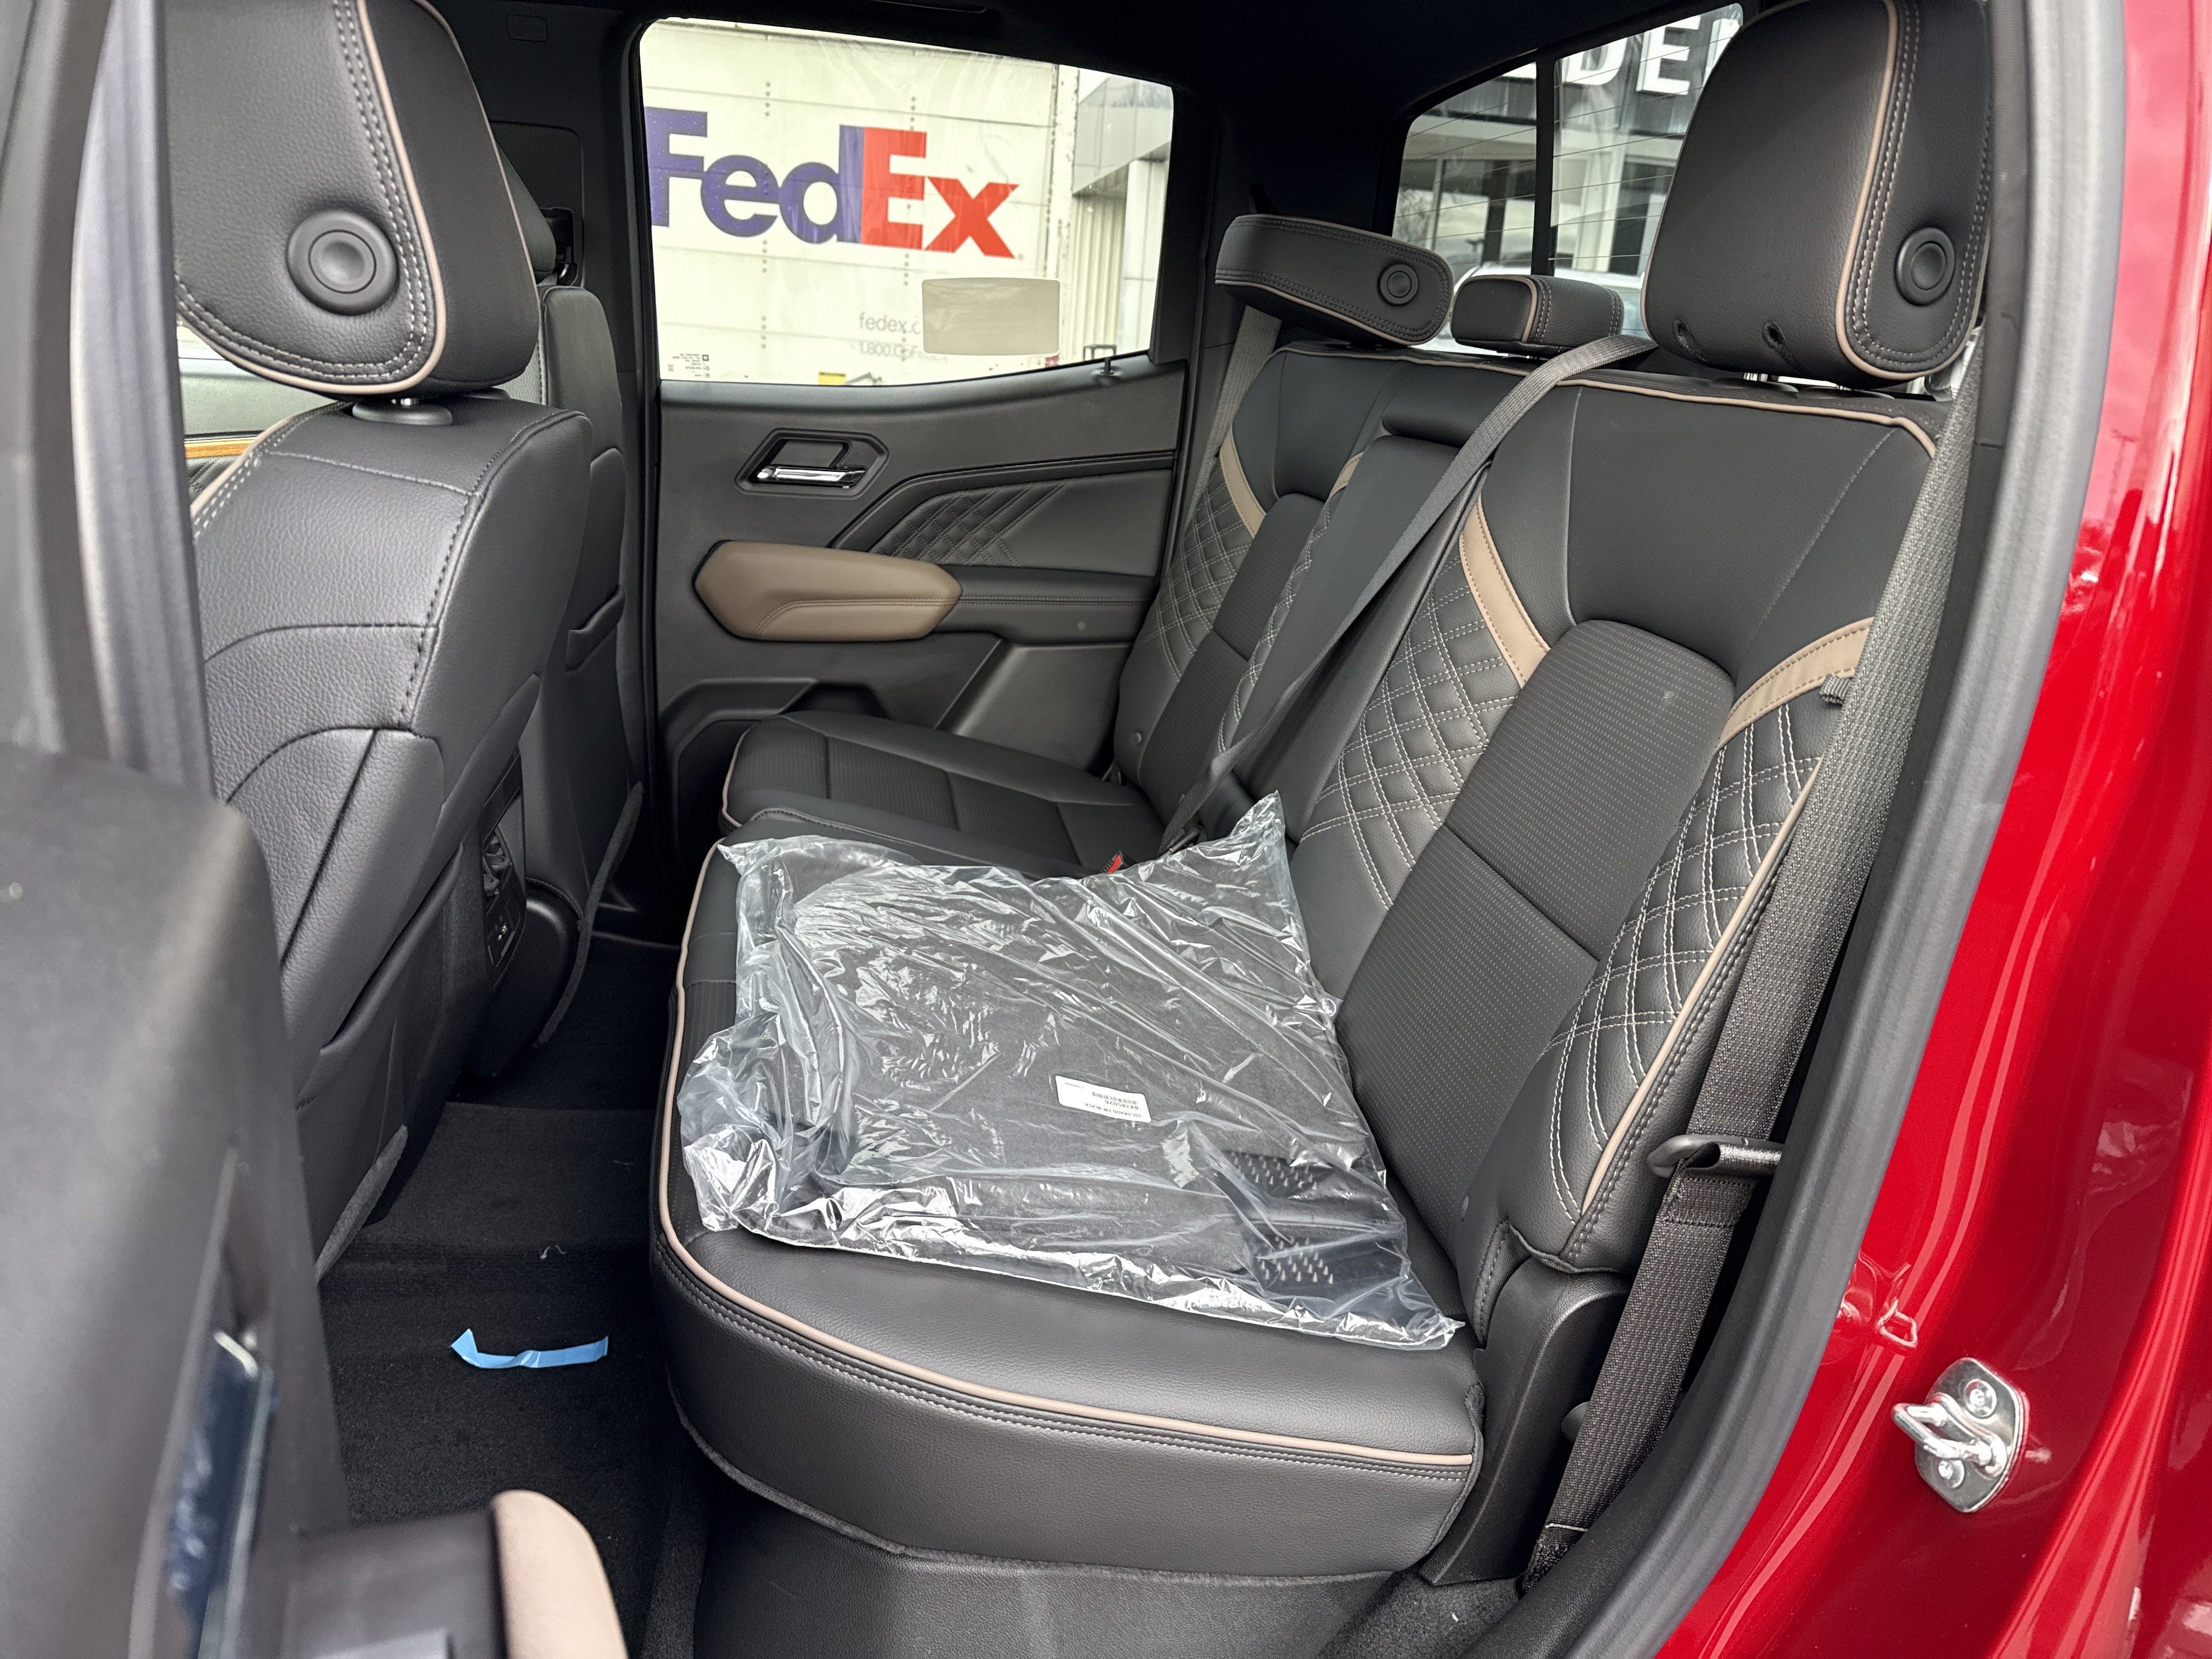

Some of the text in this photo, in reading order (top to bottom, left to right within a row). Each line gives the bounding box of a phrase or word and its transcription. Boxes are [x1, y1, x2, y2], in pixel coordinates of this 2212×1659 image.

[644, 106, 1020, 260] FedEx
[859, 311, 921, 335] fedex.c
[1113, 1109, 1142, 1118] COLORADO
